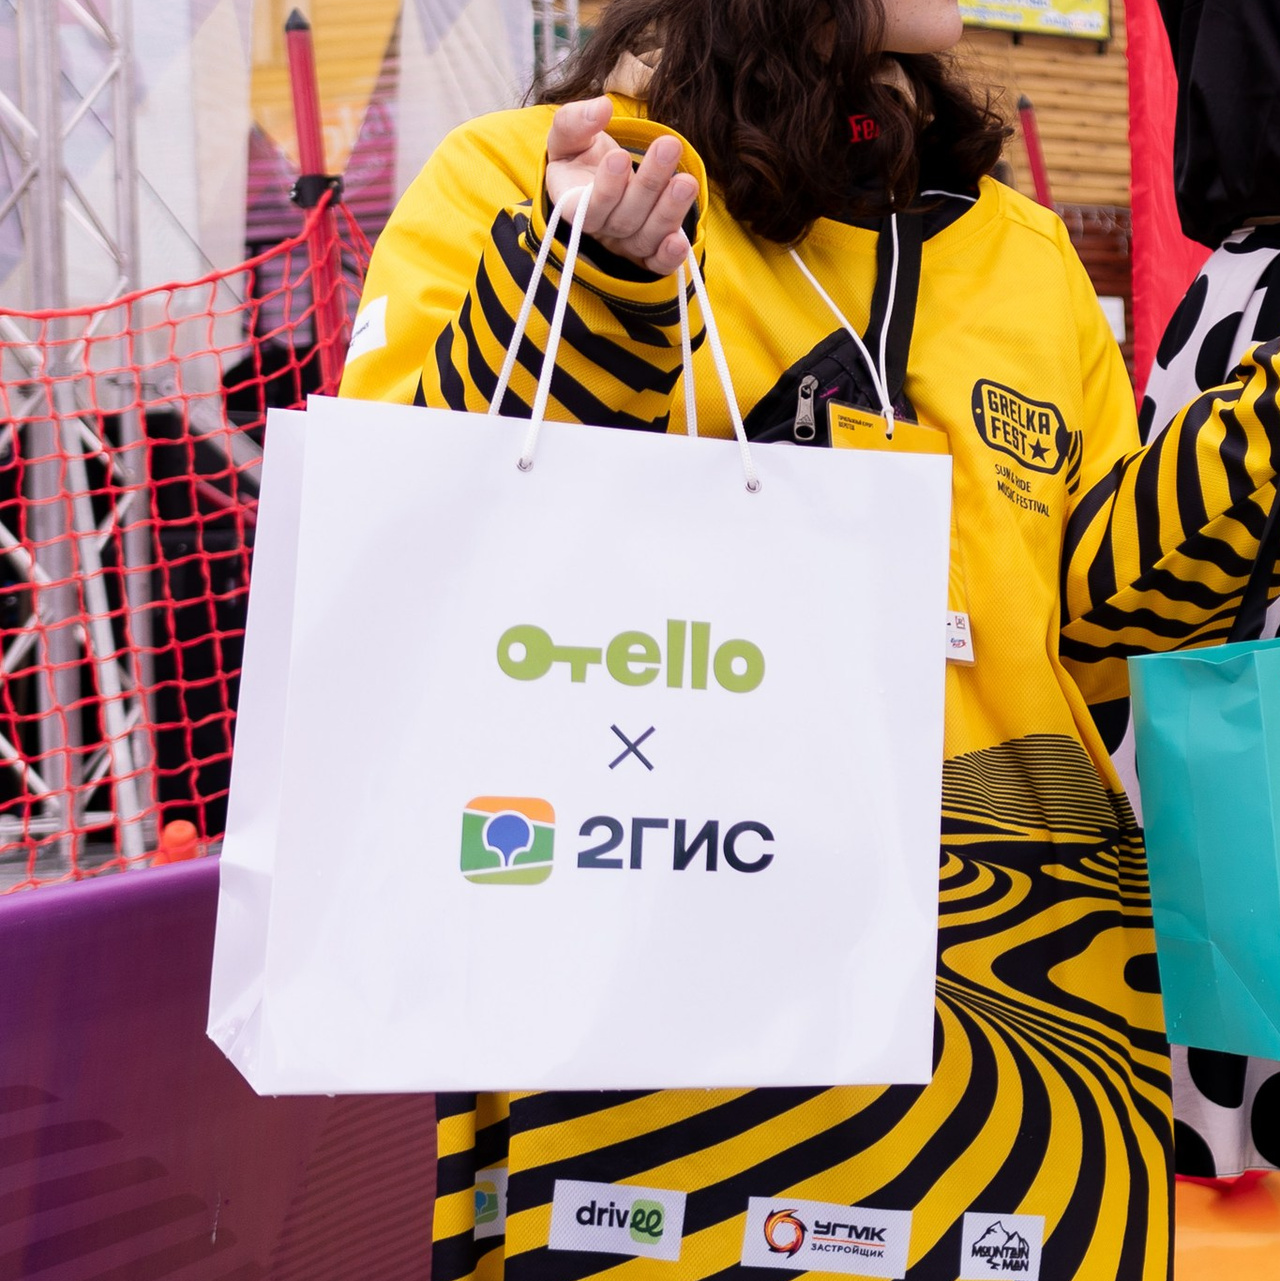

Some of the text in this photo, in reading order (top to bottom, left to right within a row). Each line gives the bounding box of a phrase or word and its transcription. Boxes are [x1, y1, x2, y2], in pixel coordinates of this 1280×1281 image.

[847, 114, 880, 144] Fe
[987, 389, 1051, 436] GRELKA
[990, 415, 1028, 456] FEST
[997, 480, 1050, 518] MUSIC FESTIVAL
[576, 815, 776, 874] 2ГИС
[575, 1200, 664, 1238] drivee
[812, 1219, 887, 1243] УГМК
[811, 1242, 885, 1259] ЗАСТРОЙЩИК
[971, 1245, 1030, 1260] MOUNTAIN
[1002, 1258, 1029, 1271] MAN
